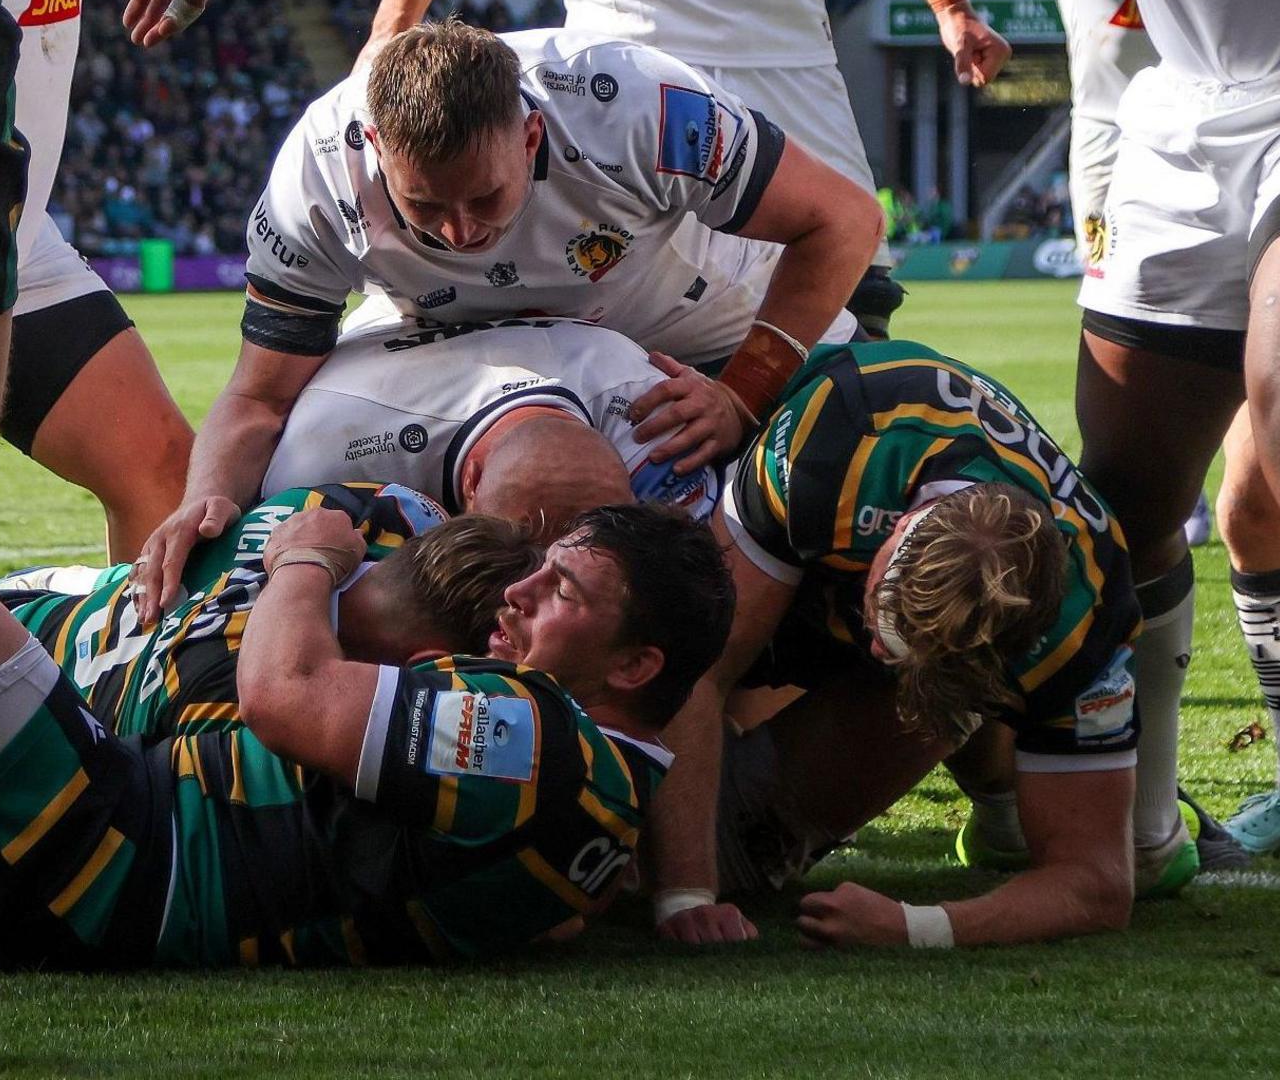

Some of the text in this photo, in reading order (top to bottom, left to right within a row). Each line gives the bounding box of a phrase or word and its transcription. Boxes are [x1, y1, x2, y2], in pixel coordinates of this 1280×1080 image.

[545, 79, 586, 96] Universi
[254, 200, 296, 269] vertu
[343, 442, 396, 463] University
[347, 431, 395, 450] of Exeter
[456, 695, 475, 770] PREM
[473, 696, 491, 771] Gallagher
